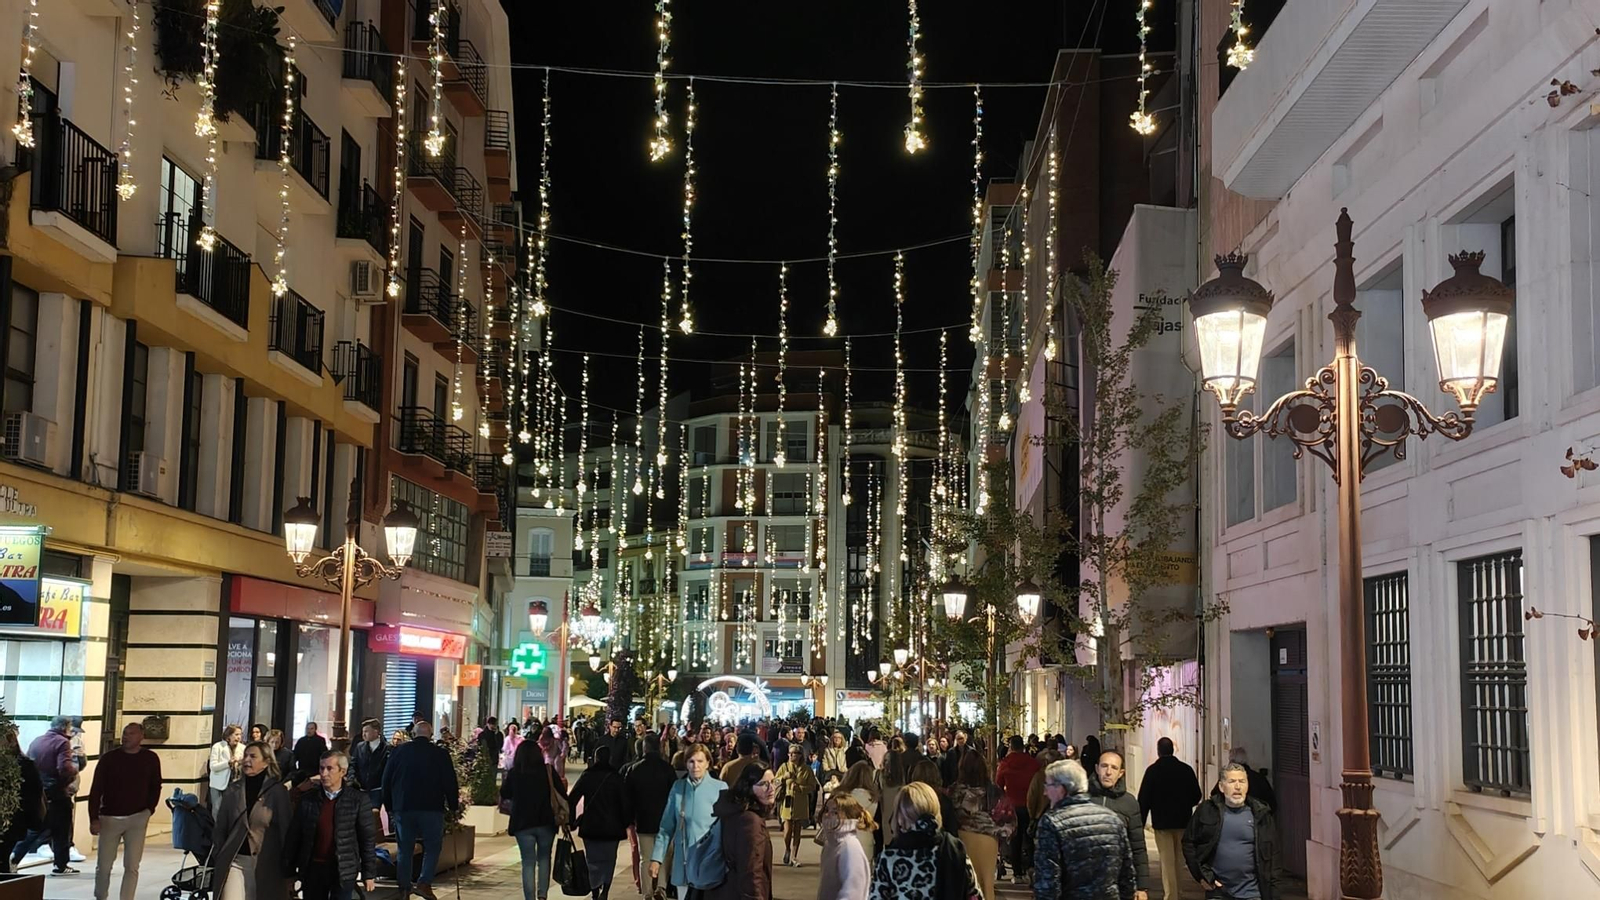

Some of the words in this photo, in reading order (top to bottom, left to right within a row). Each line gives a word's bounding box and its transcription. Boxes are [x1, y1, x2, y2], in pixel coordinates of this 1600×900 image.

[1139, 293, 1182, 305] Fundac
[0, 536, 40, 546] UEGOS
[0, 564, 37, 578] TRA
[41, 586, 56, 603] afé
[60, 587, 79, 602] Bar
[39, 606, 68, 629] RA
